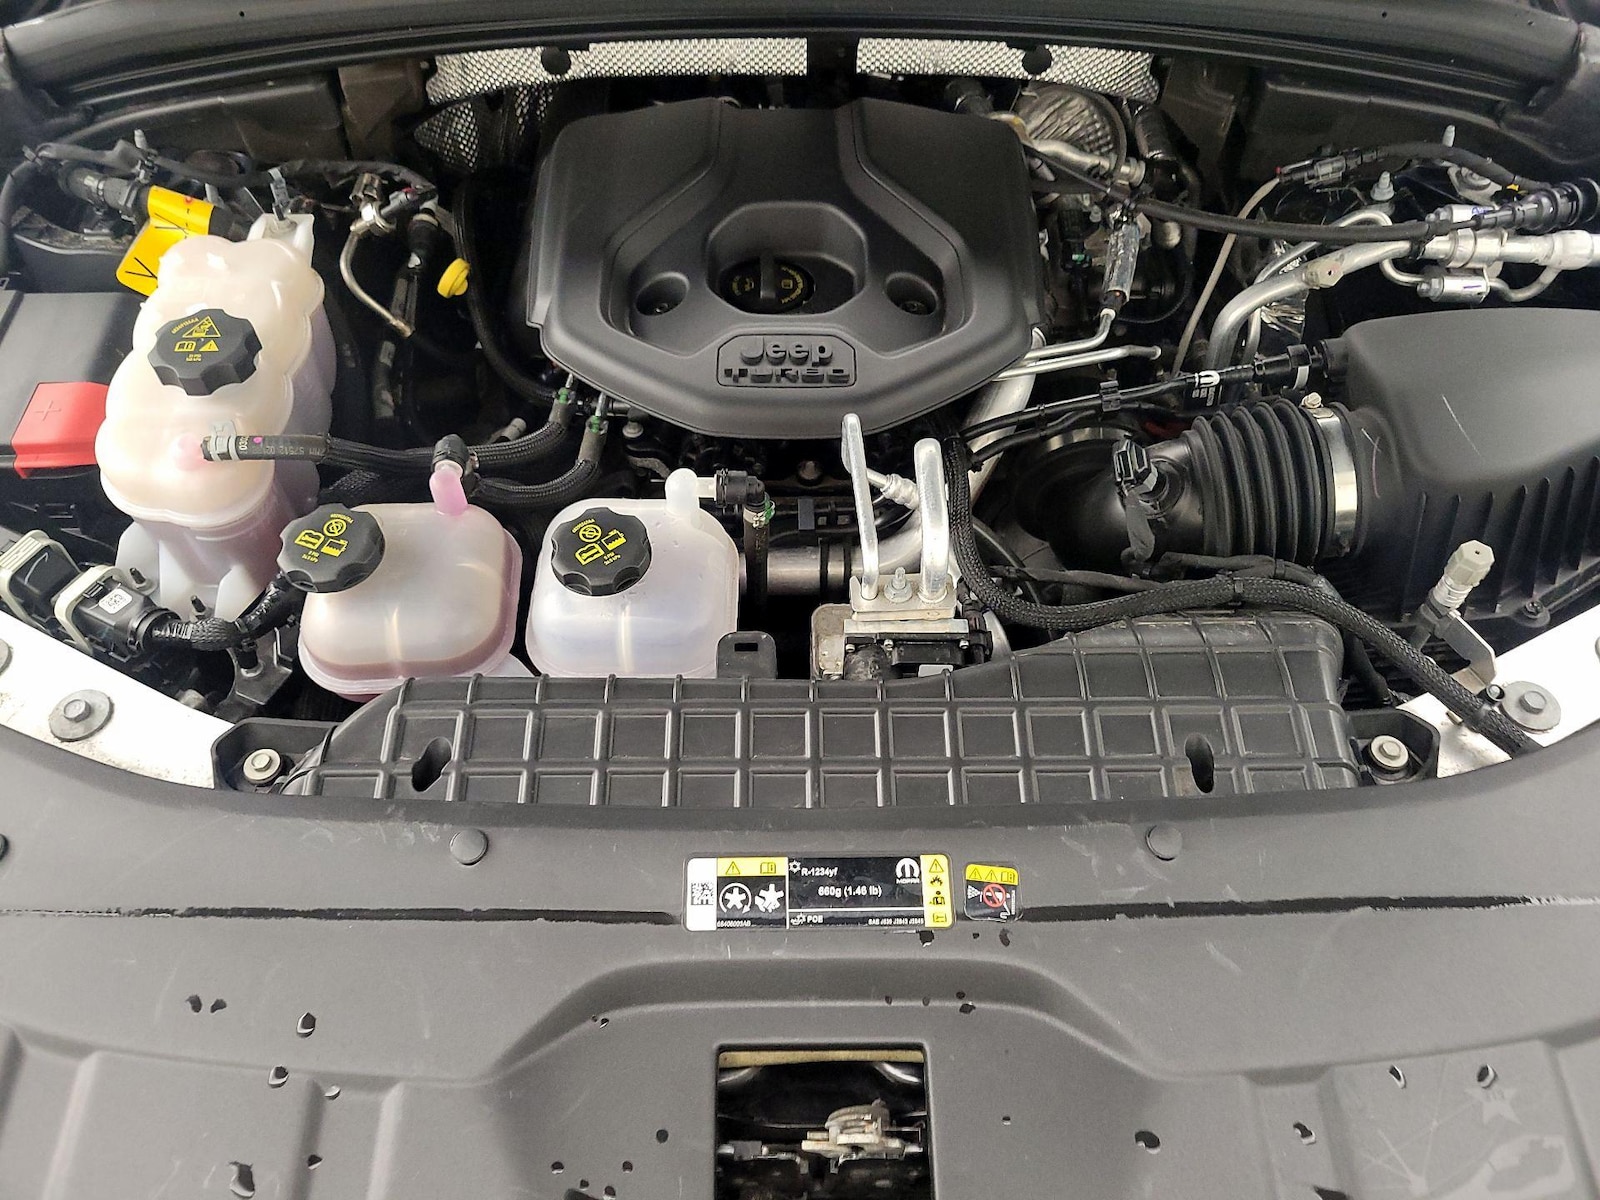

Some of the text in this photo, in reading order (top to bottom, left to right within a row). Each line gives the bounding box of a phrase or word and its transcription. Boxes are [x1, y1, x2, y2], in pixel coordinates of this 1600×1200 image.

[740, 336, 834, 367] Jeep
[724, 367, 851, 384] TURBO
[801, 867, 838, 878] R-1234yf
[818, 885, 882, 898] 660g (1.46 lb)
